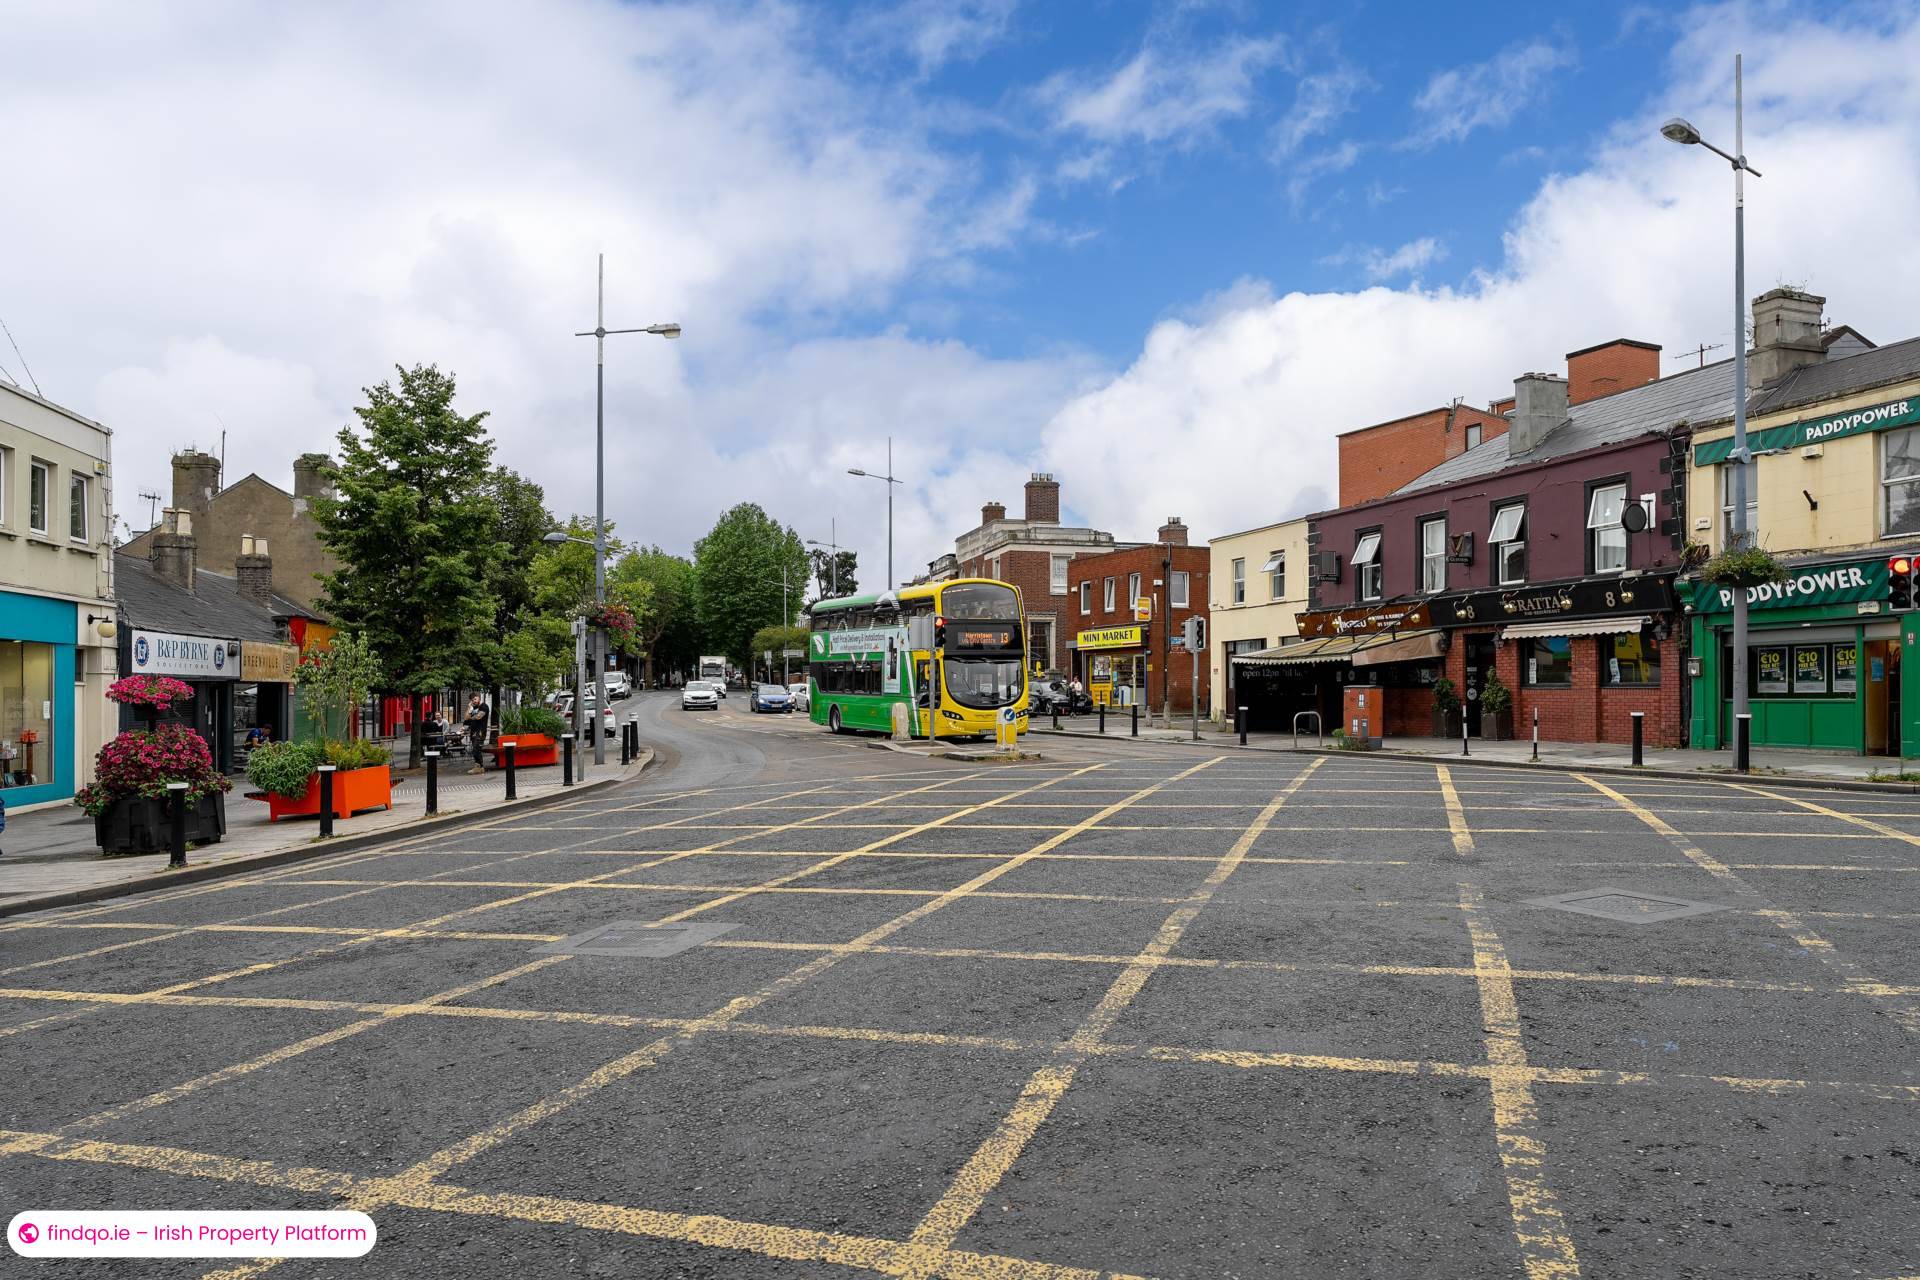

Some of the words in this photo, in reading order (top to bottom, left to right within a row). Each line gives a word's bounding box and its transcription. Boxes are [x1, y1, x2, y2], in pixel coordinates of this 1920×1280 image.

[1718, 567, 1873, 607] PDDYPOWER.
[1605, 591, 1616, 608] 8
[1466, 605, 1475, 619] 8
[1000, 632, 1009, 643] 13
[1083, 634, 1100, 642] MINI
[1102, 630, 1134, 641] MARKET
[157, 639, 179, 659] B&P
[180, 641, 209, 661] BYRNE
[1798, 651, 1818, 663] €10
[243, 655, 279, 669] GREENVILLE
[1761, 653, 1780, 664] €10
